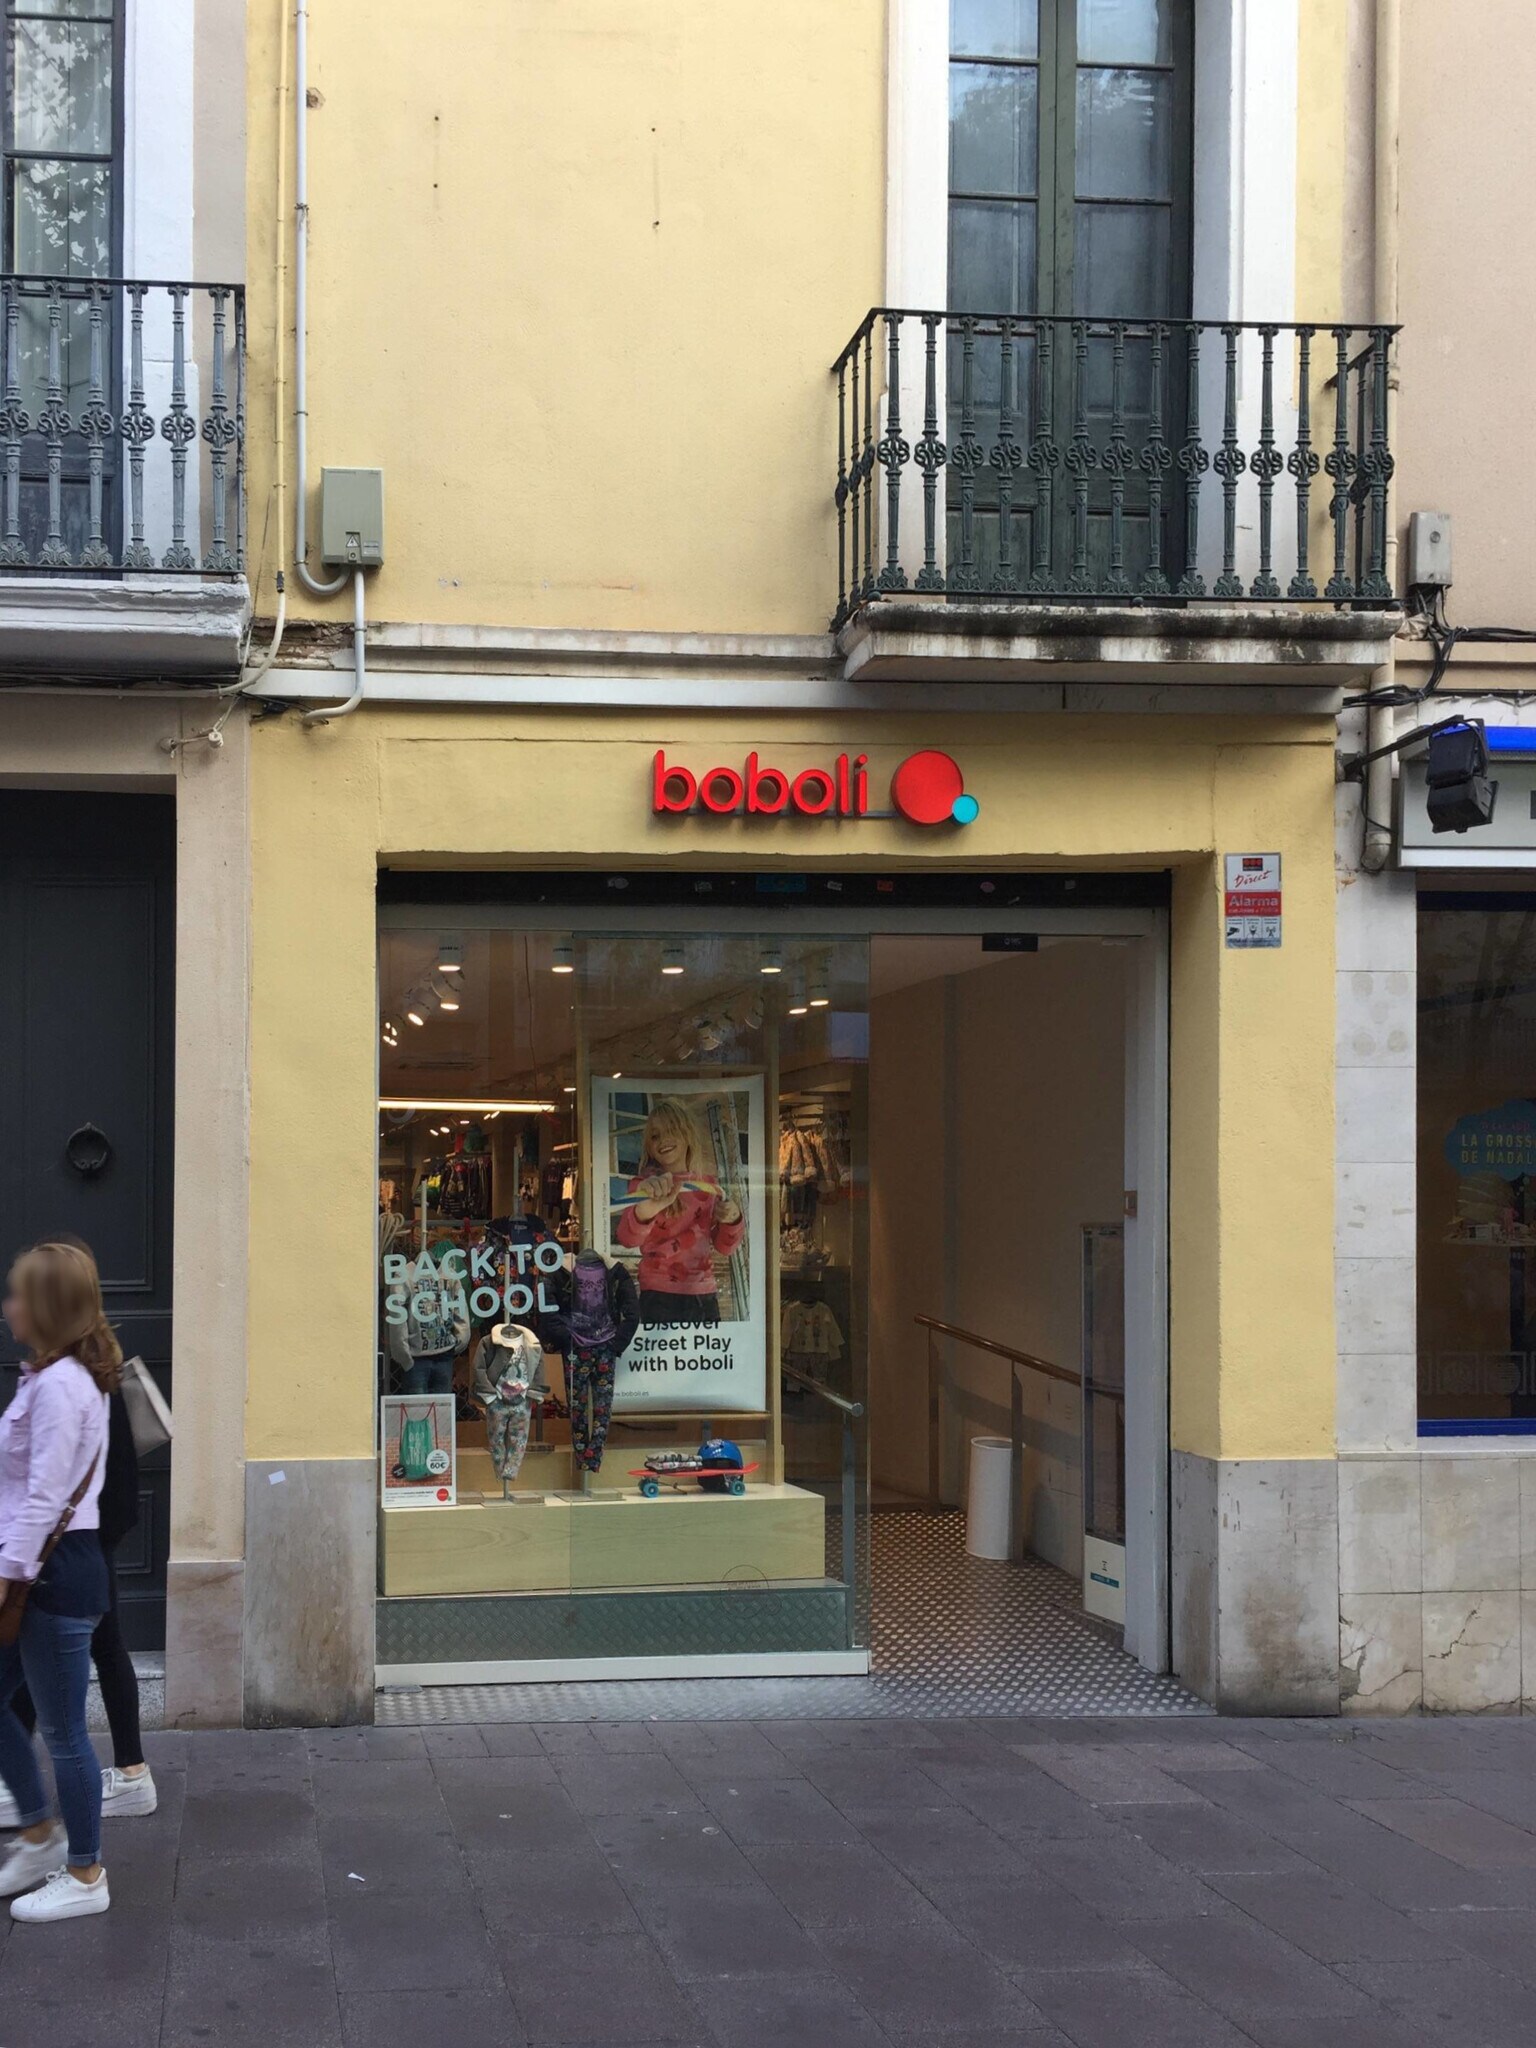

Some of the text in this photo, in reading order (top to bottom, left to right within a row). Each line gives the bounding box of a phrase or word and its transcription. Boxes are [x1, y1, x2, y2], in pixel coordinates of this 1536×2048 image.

[653, 749, 868, 815] boboli
[1230, 895, 1278, 907] Alarma
[1486, 1134, 1536, 1147] GROSS
[383, 1241, 564, 1286] BACK TO
[385, 1282, 560, 1325] SCHOOL
[633, 1335, 731, 1352] Street Play
[629, 1354, 734, 1372] with boboli
